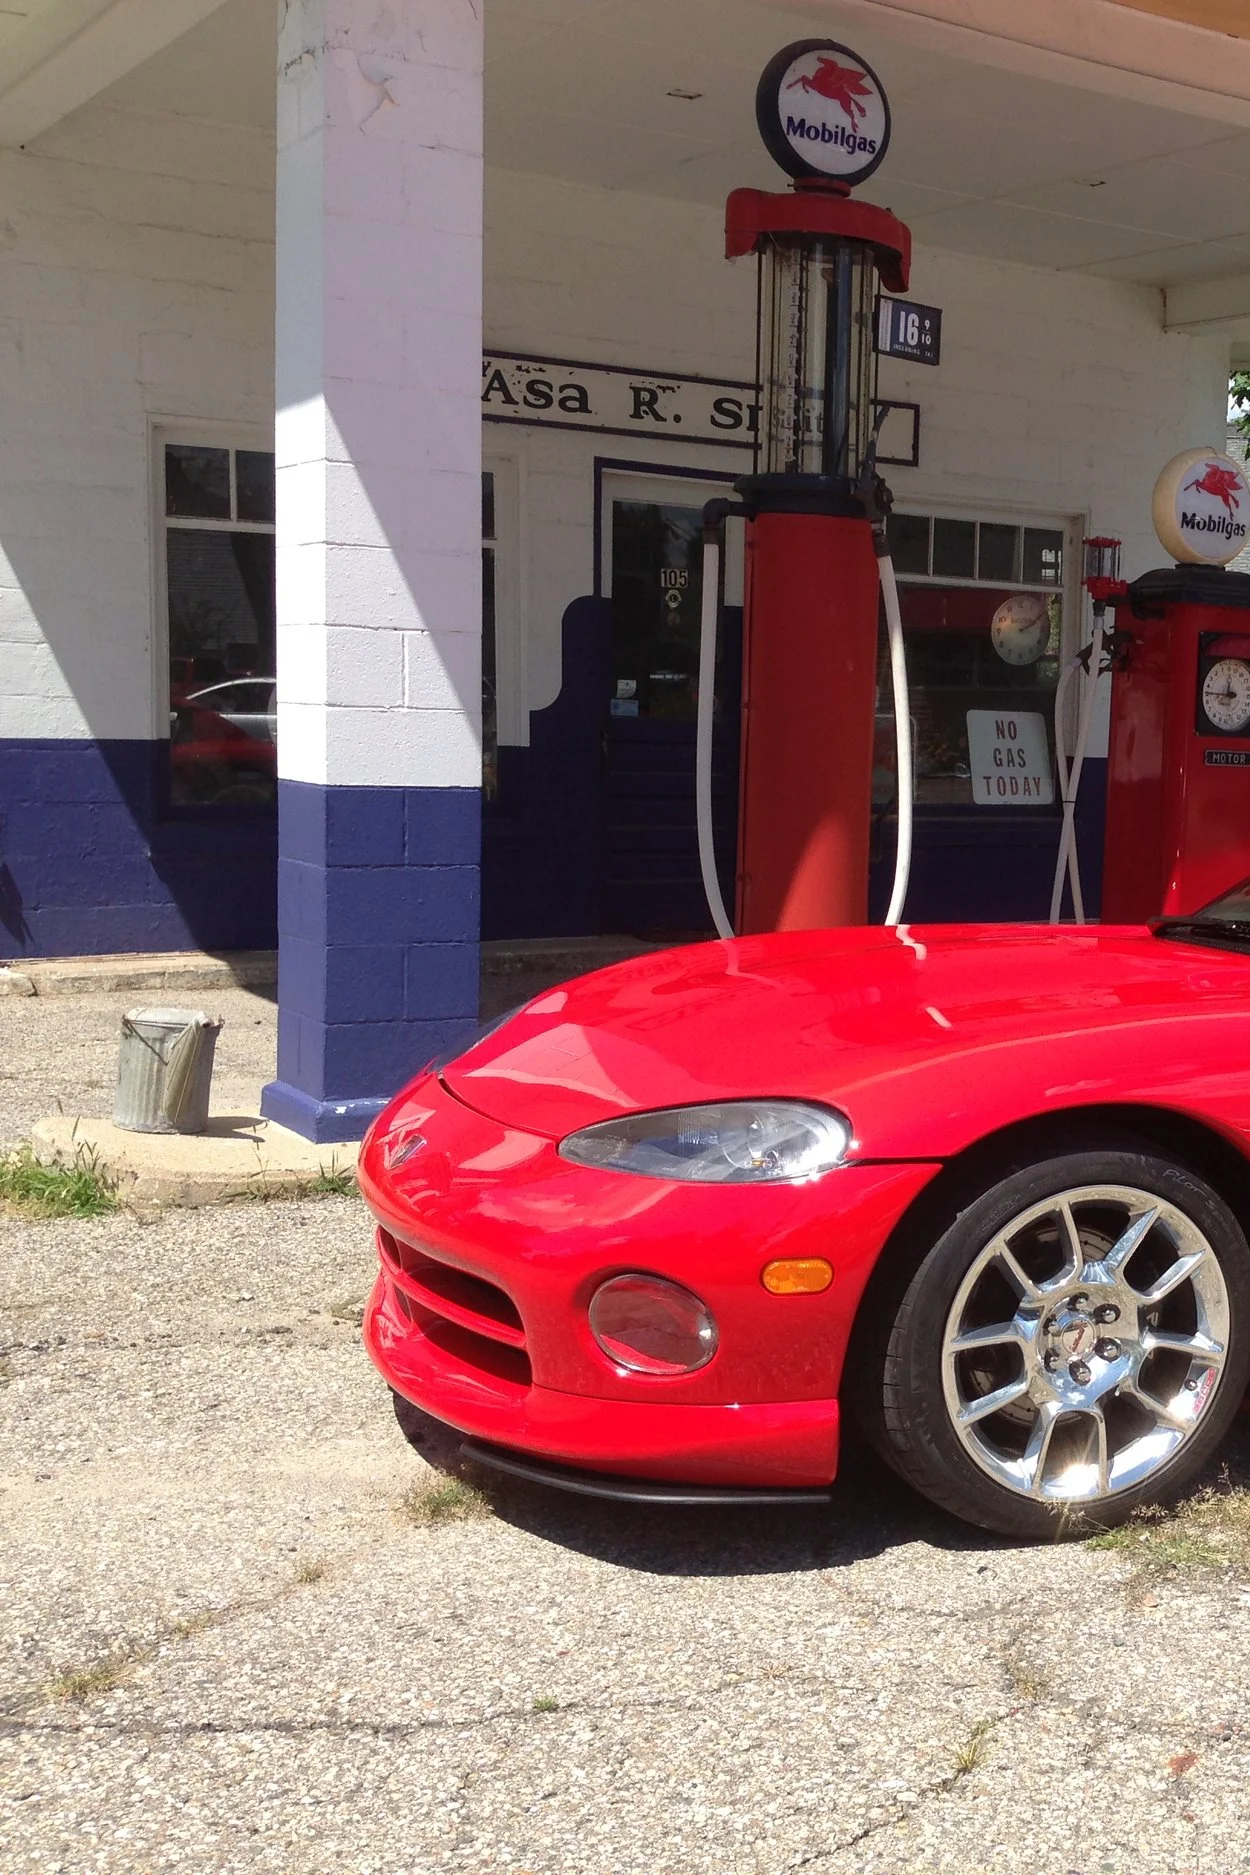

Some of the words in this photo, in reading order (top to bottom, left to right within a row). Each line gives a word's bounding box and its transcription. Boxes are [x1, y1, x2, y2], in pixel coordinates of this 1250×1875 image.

[786, 116, 877, 155] Mobilgas
[899, 311, 920, 346] 16
[481, 368, 593, 415] Asa
[629, 385, 683, 424] R.
[1180, 511, 1246, 540] Mobilgas
[662, 569, 688, 588] 105
[995, 719, 1017, 741] NO
[993, 748, 1027, 768] GAS
[1211, 752, 1247, 765] MOTOR
[982, 775, 1042, 797] TODAY
